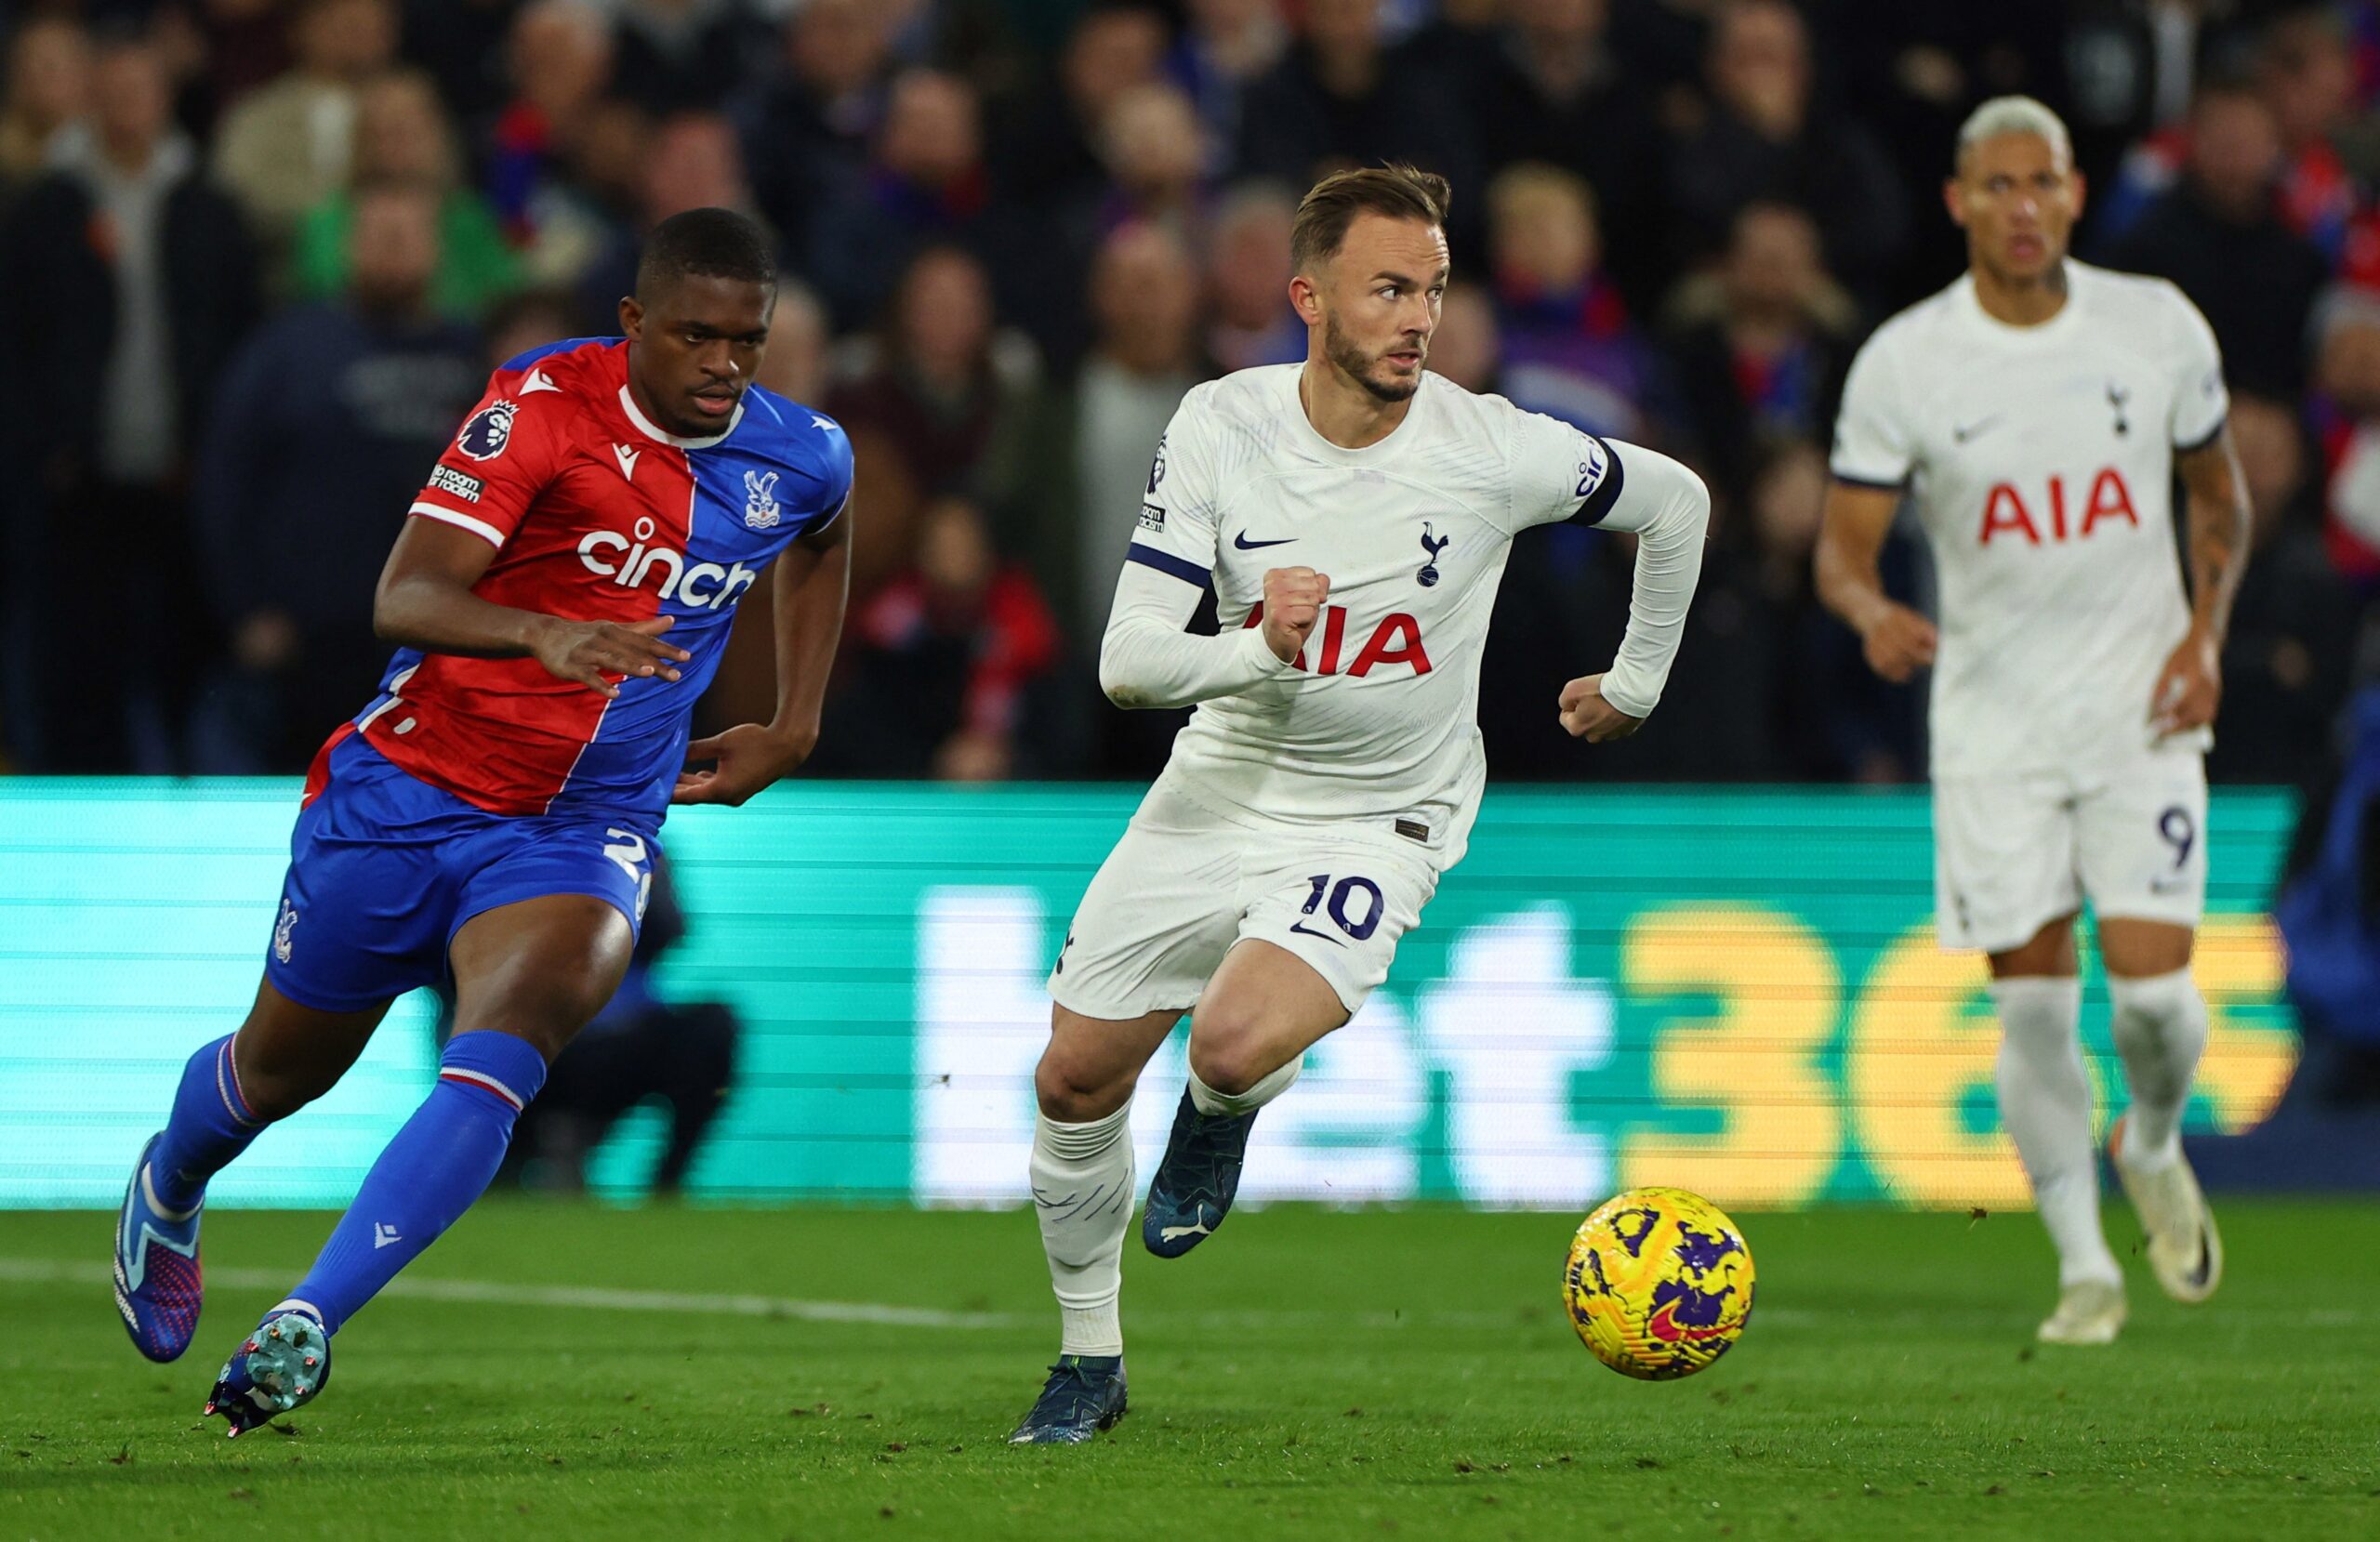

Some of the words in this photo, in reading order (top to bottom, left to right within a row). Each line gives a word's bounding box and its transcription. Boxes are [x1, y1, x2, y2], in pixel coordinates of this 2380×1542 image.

[437, 478, 481, 504] racism
[443, 468, 480, 492] room
[1978, 467, 2139, 547] AIA
[576, 516, 757, 610] cinch
[2158, 804, 2194, 870] 9
[1301, 873, 1384, 942] 10
